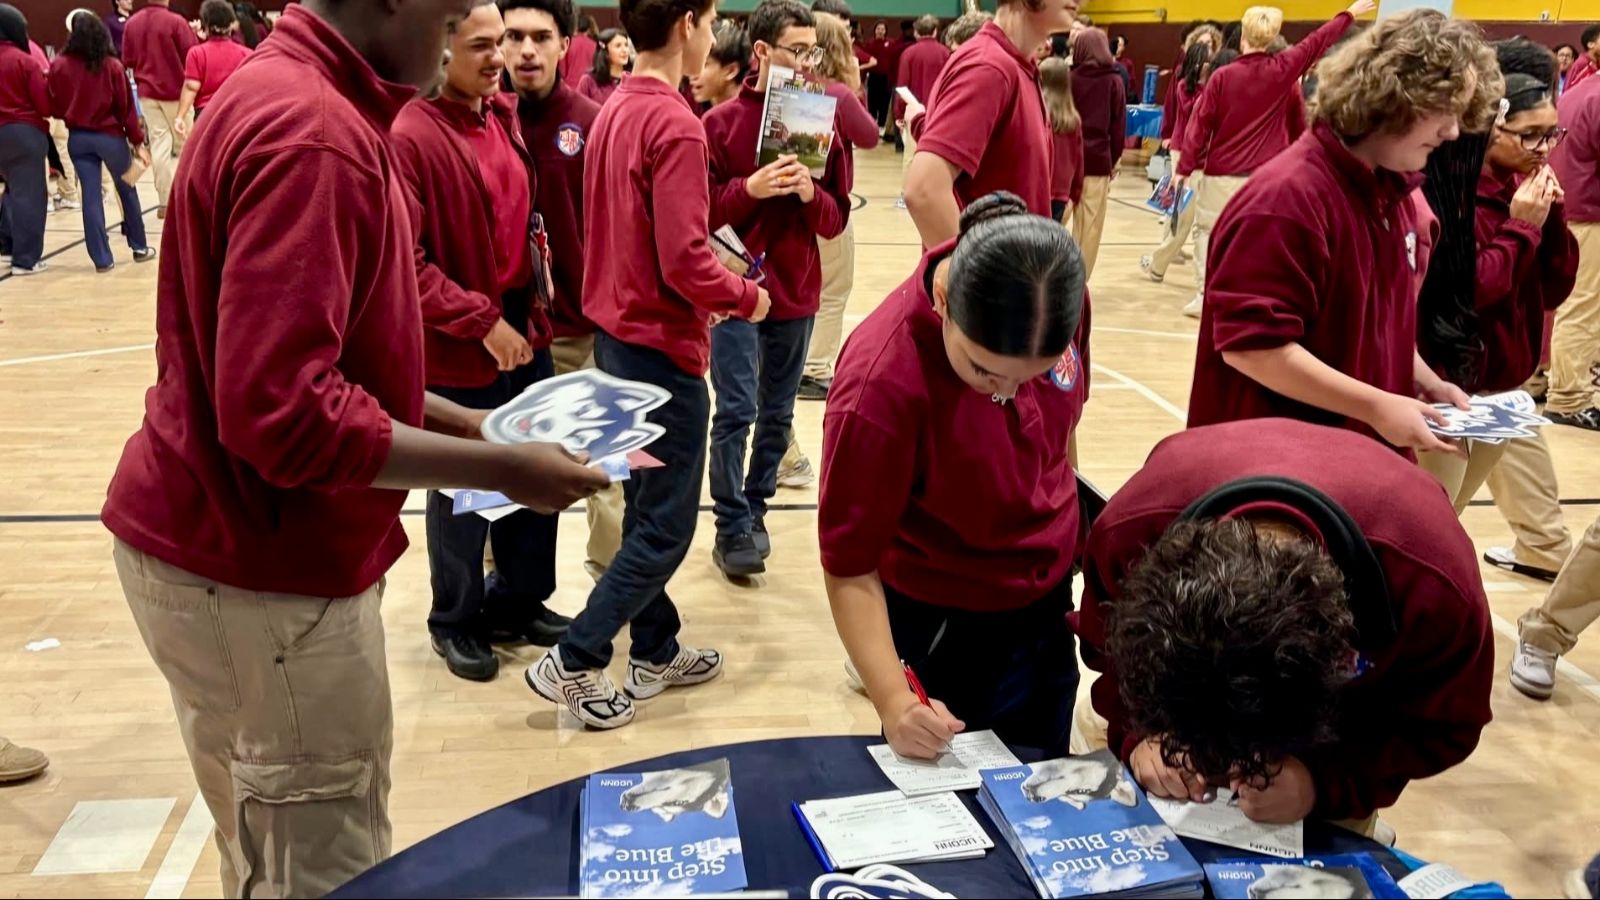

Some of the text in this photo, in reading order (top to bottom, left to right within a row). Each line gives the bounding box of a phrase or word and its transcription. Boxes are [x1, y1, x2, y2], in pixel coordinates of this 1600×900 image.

[600, 779, 633, 787] UCONN
[993, 771, 1025, 781] UCONN
[935, 837, 977, 850] UCONN
[1049, 833, 1110, 852] Blue
[616, 846, 674, 865] Blue
[1052, 845, 1169, 874] Step Into
[604, 857, 726, 884] Step Into
[1218, 870, 1256, 880] UCONN
